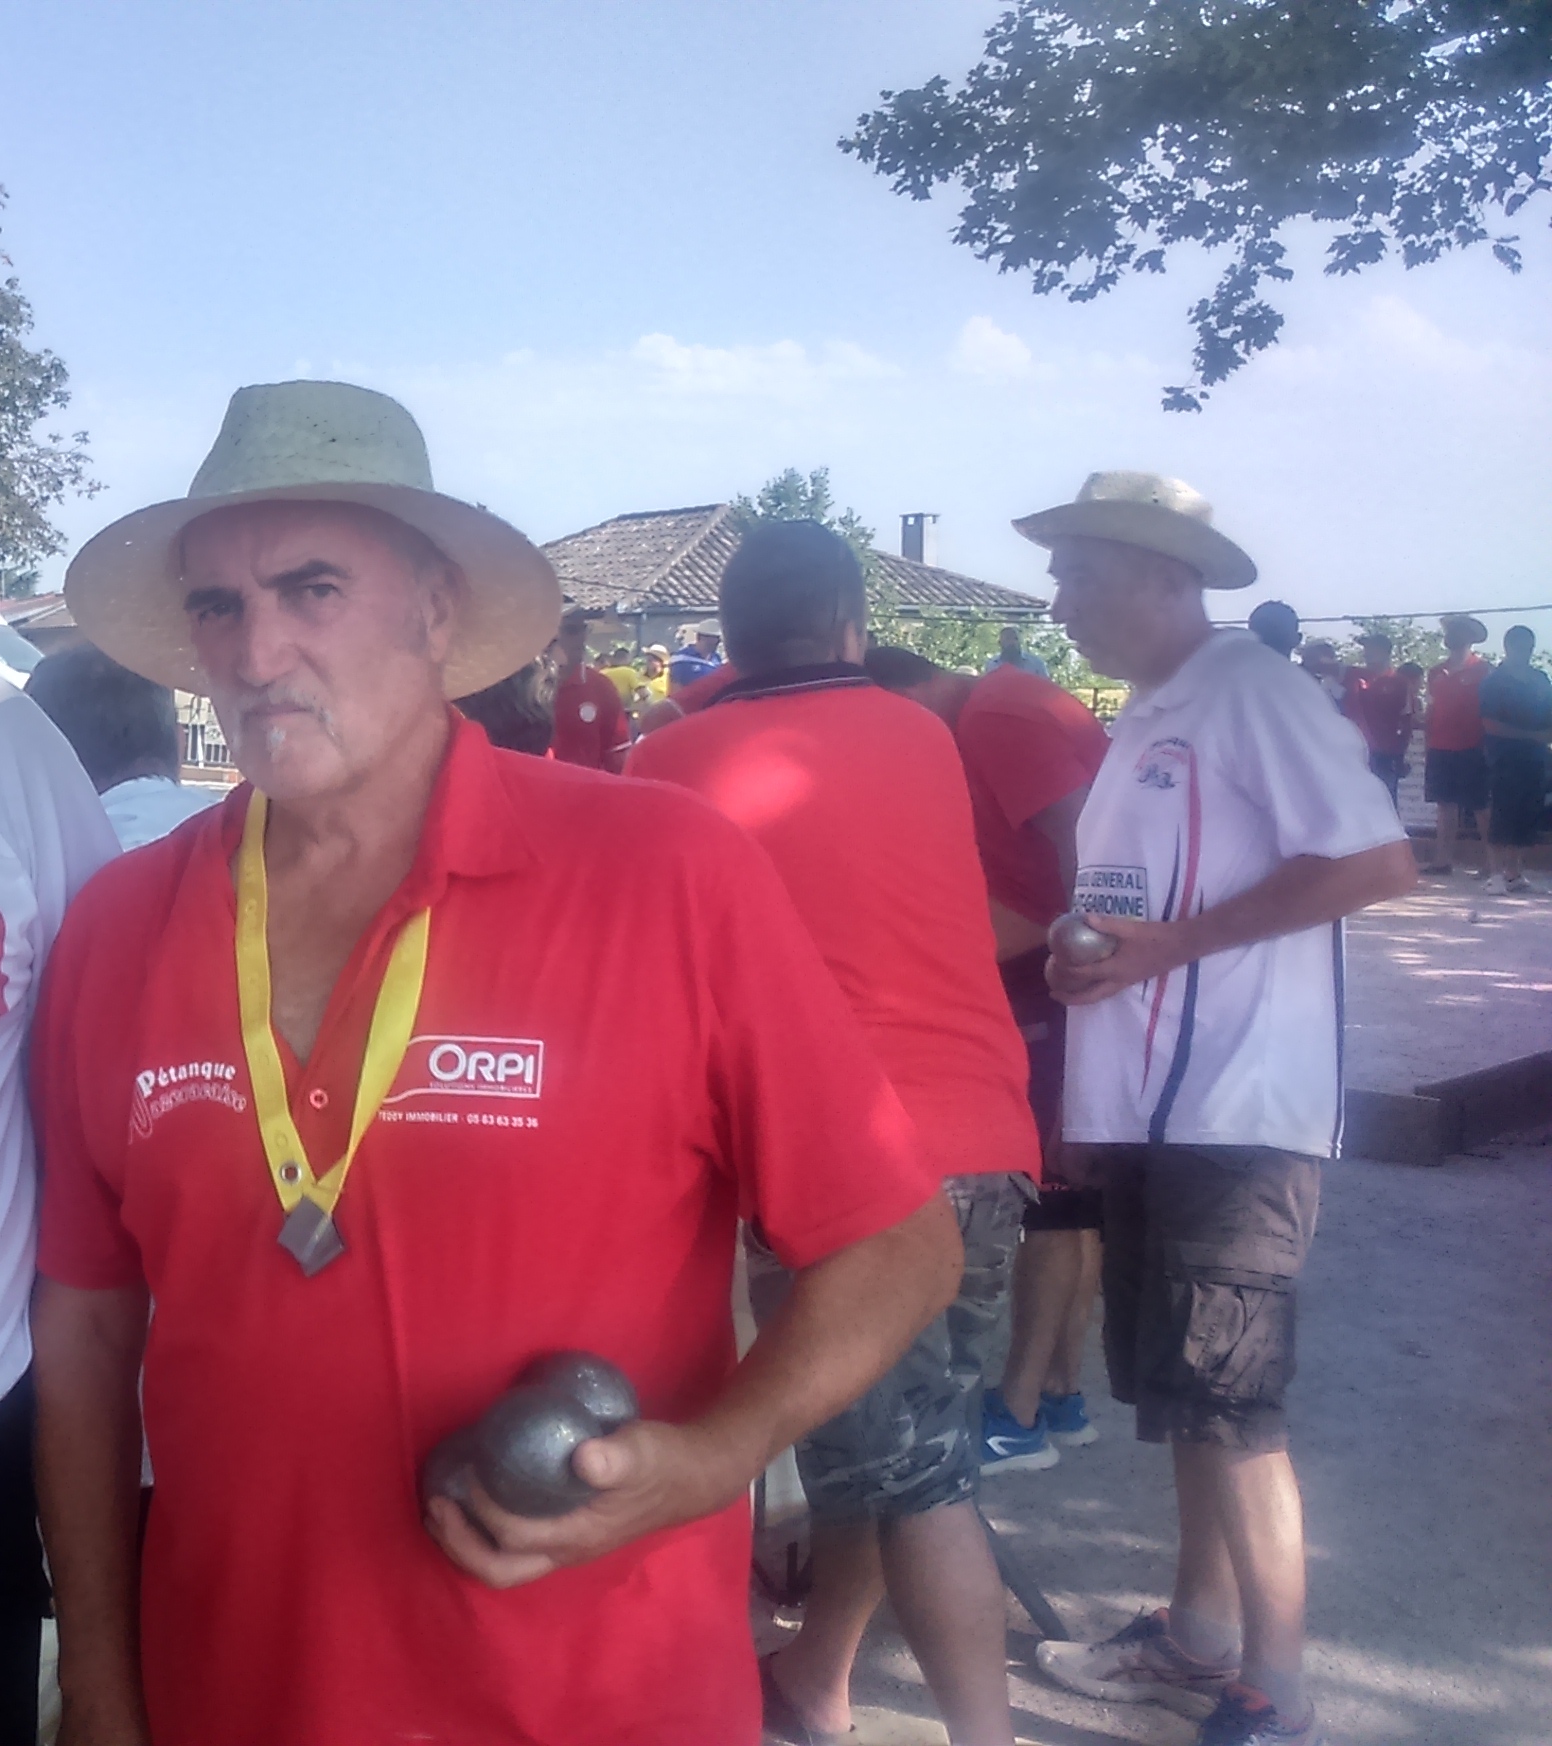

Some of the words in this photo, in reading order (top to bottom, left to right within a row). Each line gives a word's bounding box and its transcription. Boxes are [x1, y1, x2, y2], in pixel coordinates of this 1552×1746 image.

[135, 1061, 237, 1099] Pétanque
[428, 1042, 535, 1084] ORPI
[378, 1110, 403, 1122] TEDDY
[405, 1111, 459, 1124] IMMOBILIER
[482, 1113, 494, 1126] 63
[496, 1114, 510, 1127] 63
[511, 1115, 524, 1128] 35
[525, 1116, 539, 1129] 36
